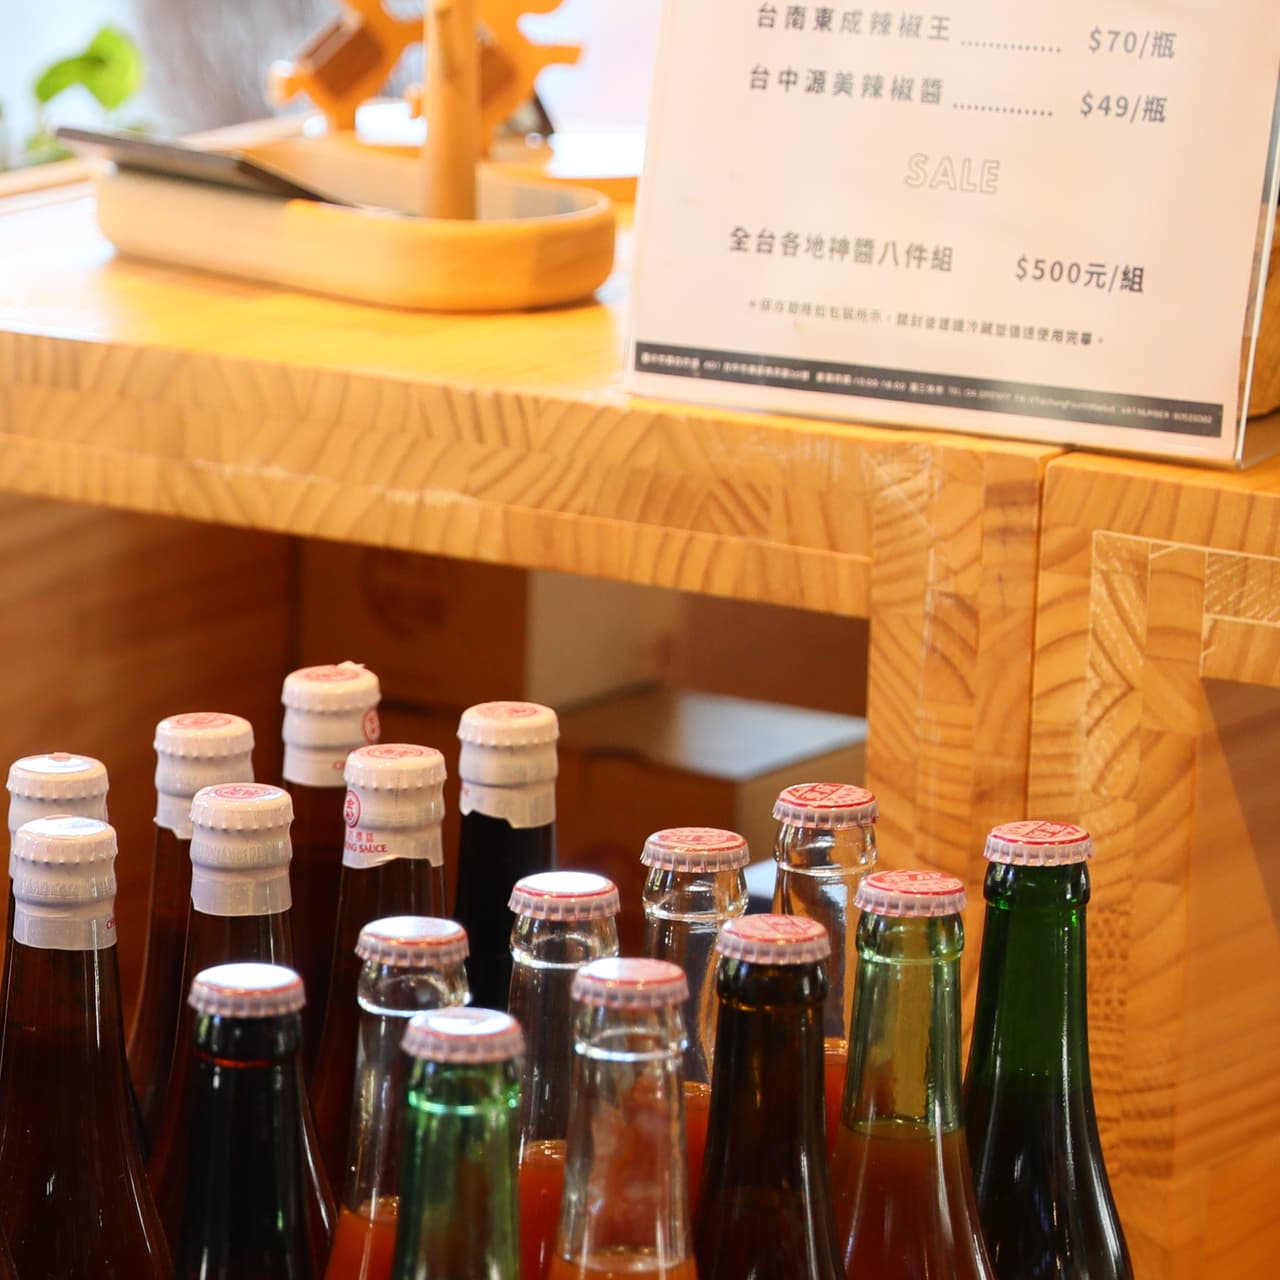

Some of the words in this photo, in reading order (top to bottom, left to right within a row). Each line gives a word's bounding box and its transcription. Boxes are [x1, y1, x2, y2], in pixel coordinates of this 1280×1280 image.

[1089, 29, 1177, 60] $70/瓶
[749, 64, 944, 105] 台中源美辣椒醬
[1080, 91, 1168, 123] $49/瓶
[904, 153, 1001, 194] SALE
[728, 225, 954, 274] 全台各地神醬八件組
[1015, 256, 1145, 294] $500元/組
[359, 844, 388, 854] SAUCE
